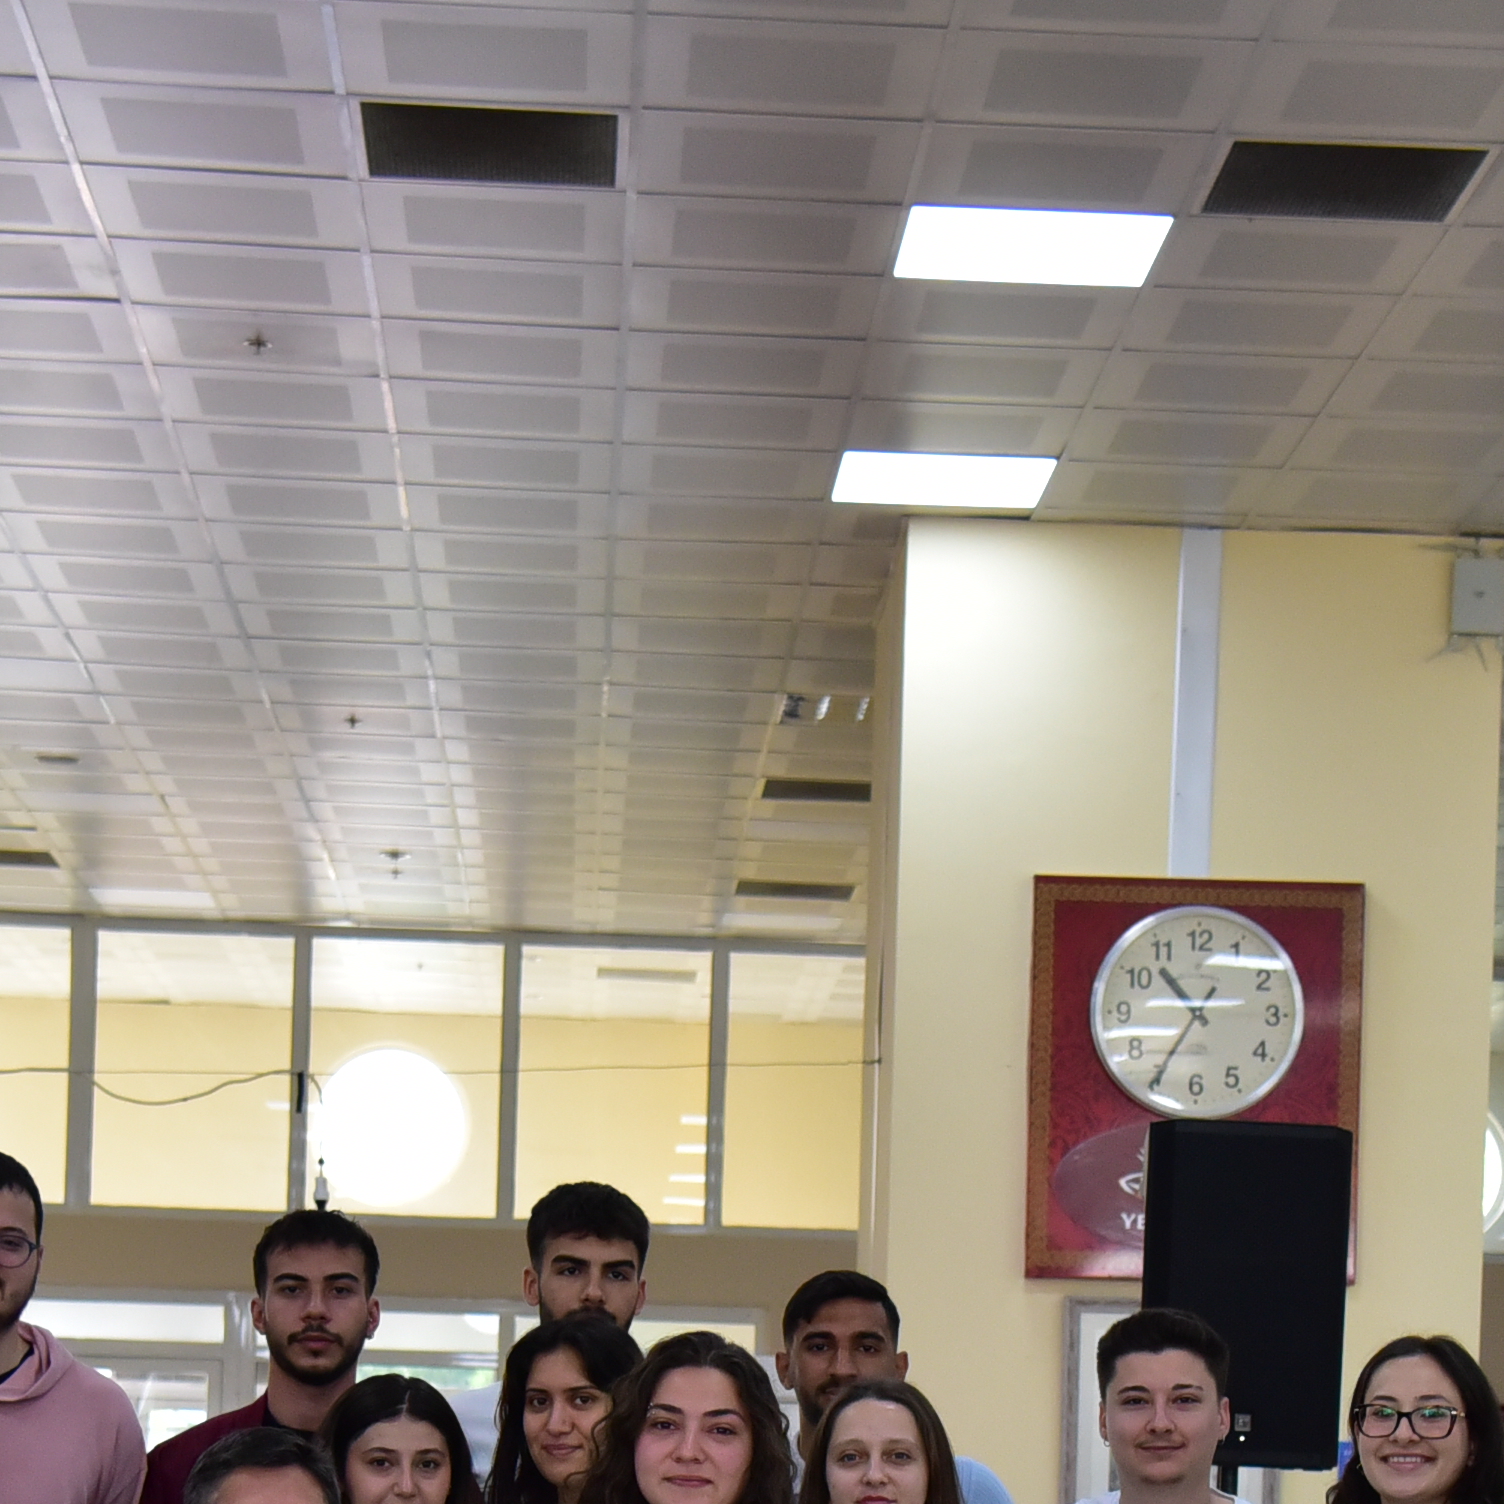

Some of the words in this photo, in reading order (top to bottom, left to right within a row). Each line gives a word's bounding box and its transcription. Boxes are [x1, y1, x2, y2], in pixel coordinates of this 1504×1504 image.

[1151, 940, 1173, 962] 11
[1186, 929, 1214, 952] 12
[1230, 941, 1241, 958] 1
[1126, 967, 1153, 990] 10
[1255, 970, 1271, 992] 2
[1116, 1001, 1132, 1024] 9
[1265, 1005, 1281, 1027] 3
[1128, 1038, 1144, 1060] 8
[1253, 1040, 1268, 1062] 4
[1188, 1074, 1204, 1097] 6
[1224, 1066, 1240, 1089] 5
